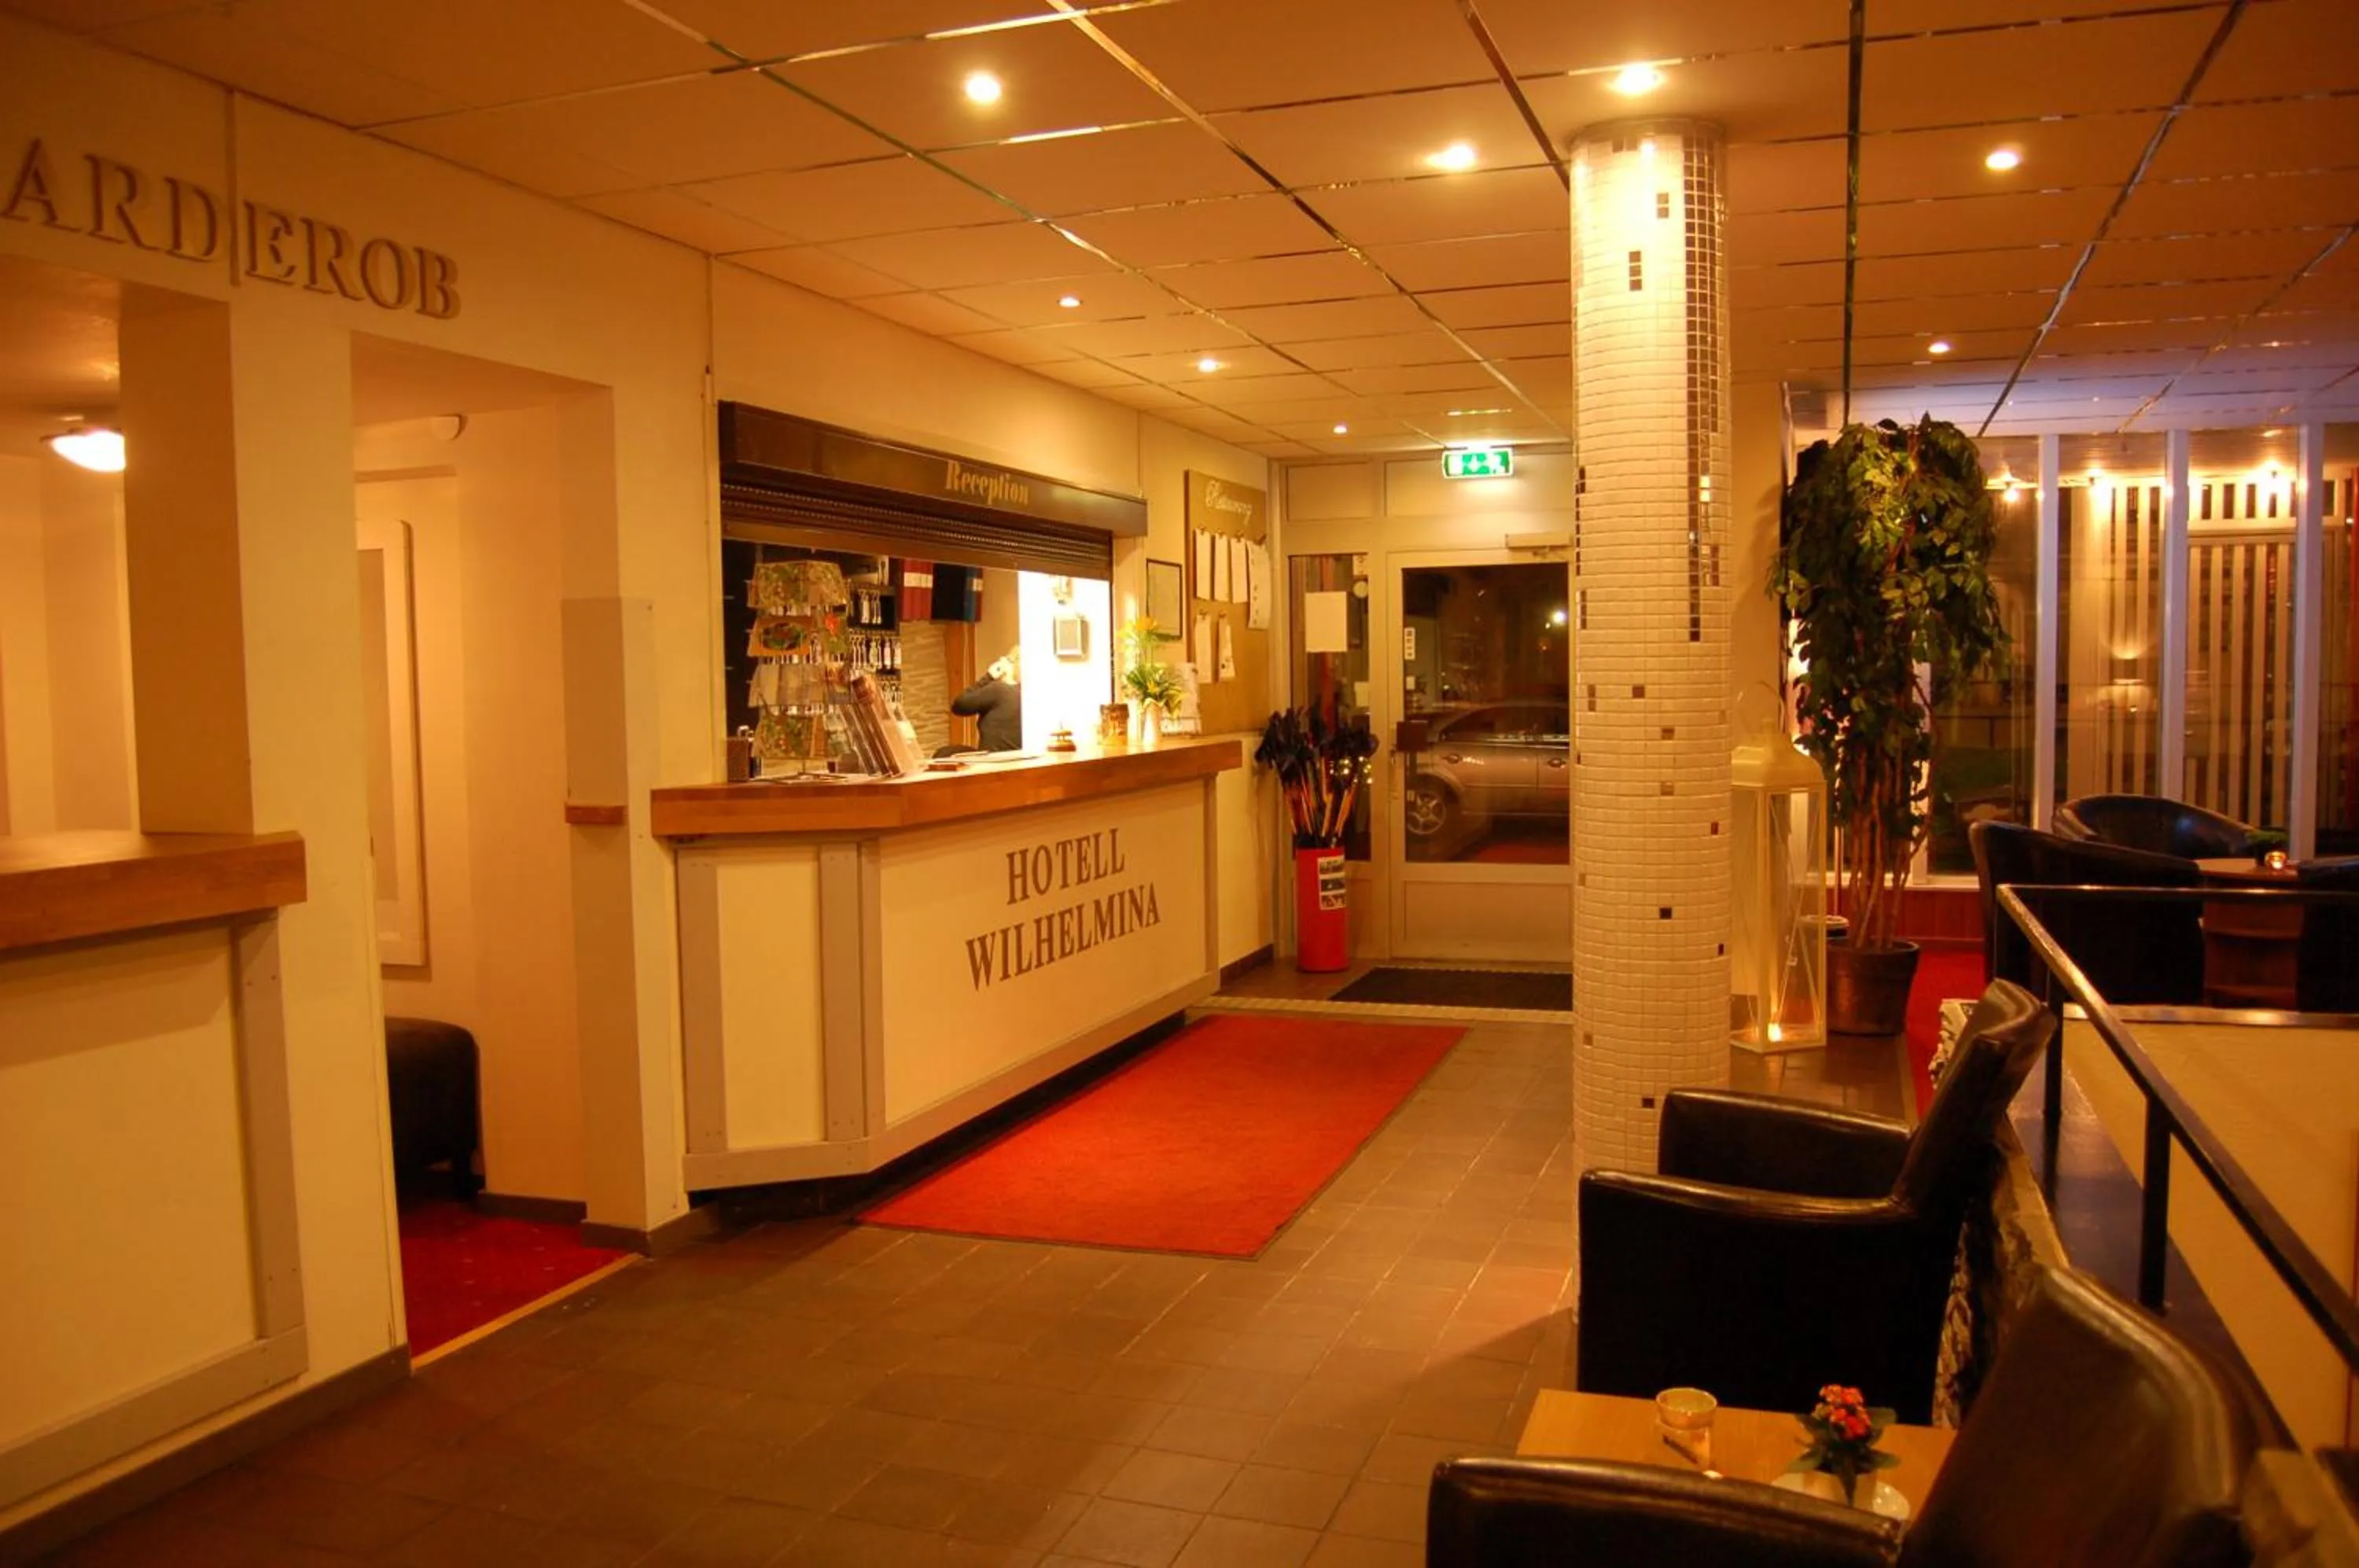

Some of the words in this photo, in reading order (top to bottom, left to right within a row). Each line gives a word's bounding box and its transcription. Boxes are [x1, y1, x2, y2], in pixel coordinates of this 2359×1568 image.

[0, 138, 460, 319] ARDEROB
[946, 459, 1029, 506] Reception
[1006, 827, 1125, 906] HOTELL
[965, 879, 1161, 992] WILHELMINA
